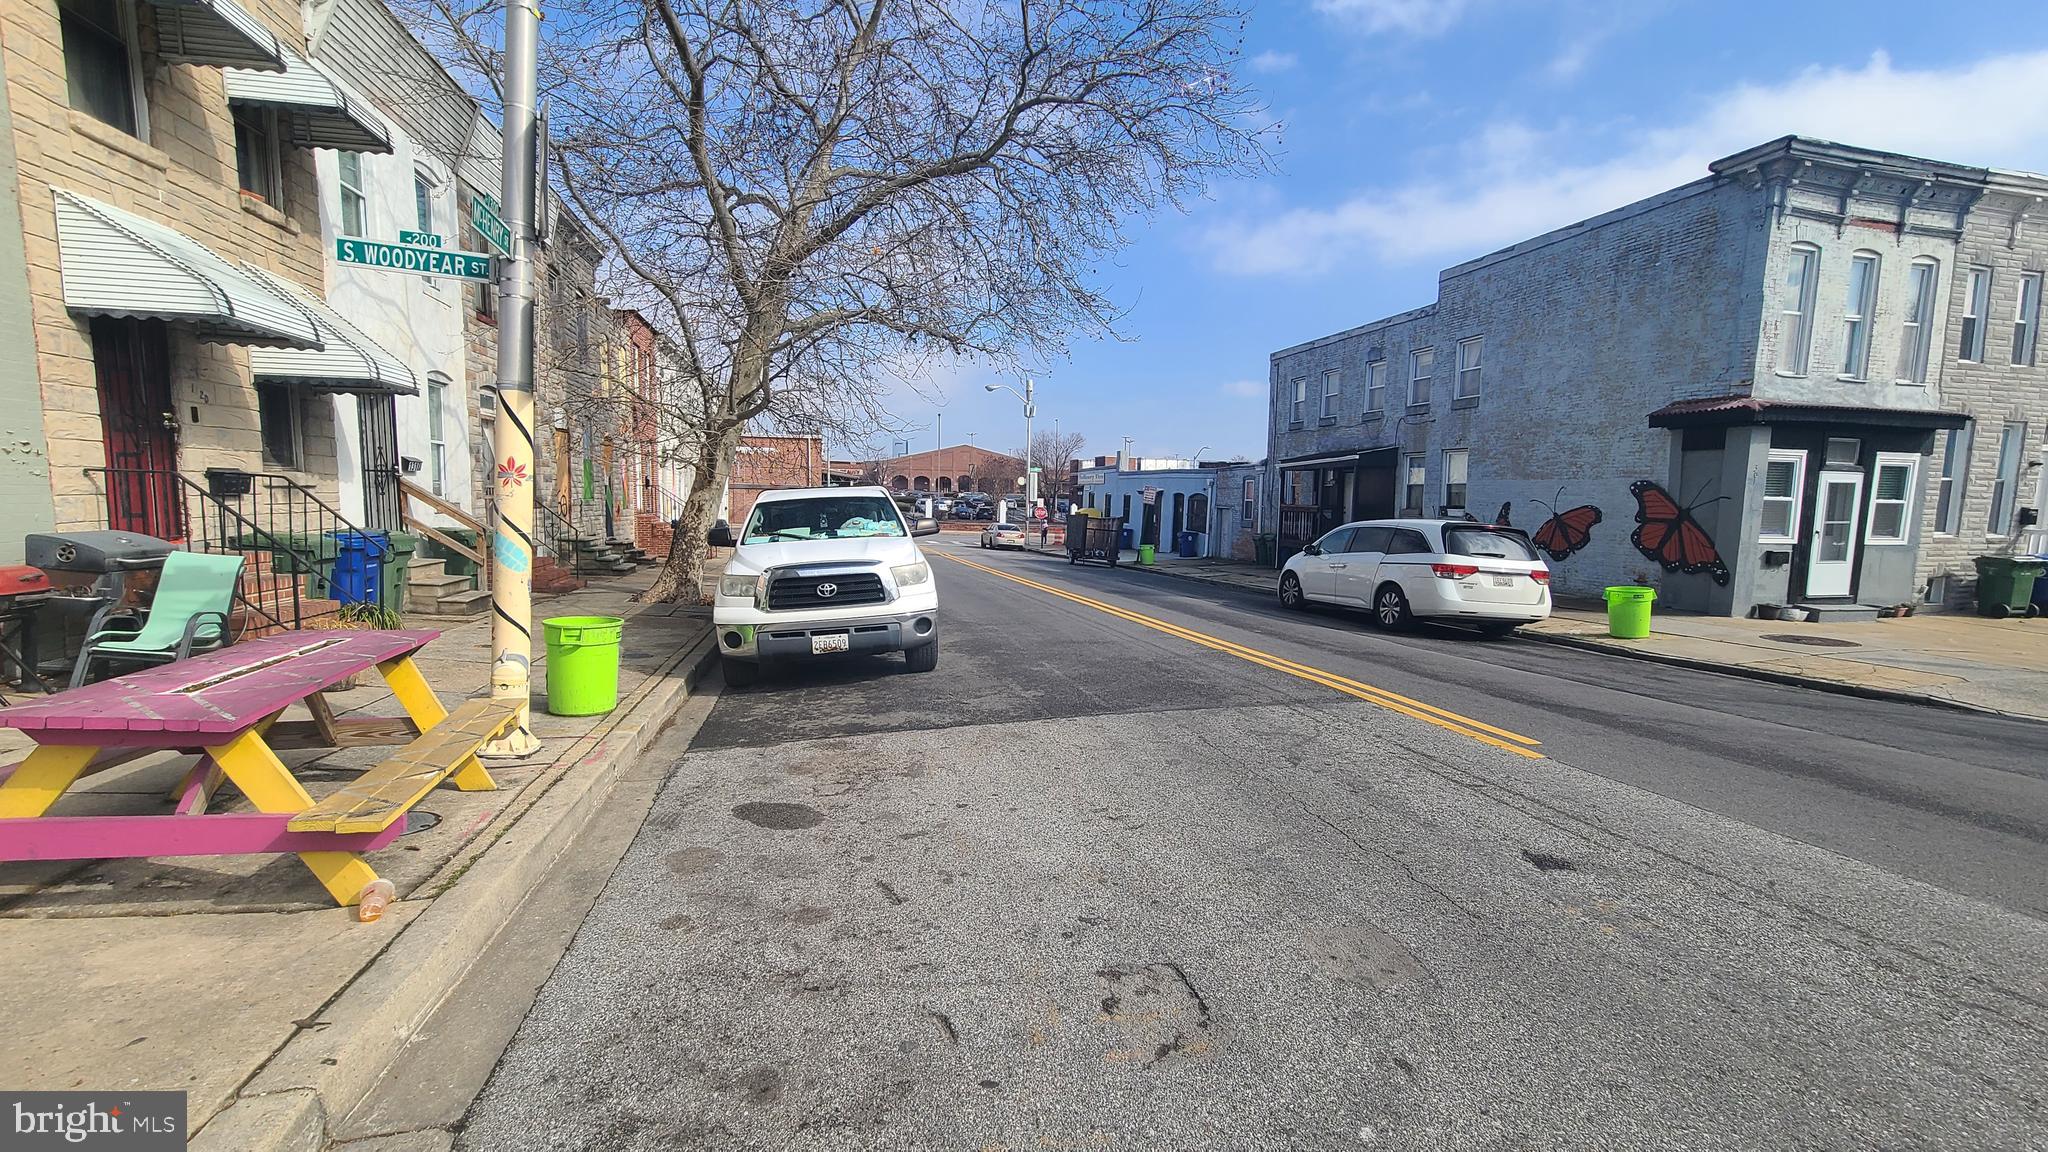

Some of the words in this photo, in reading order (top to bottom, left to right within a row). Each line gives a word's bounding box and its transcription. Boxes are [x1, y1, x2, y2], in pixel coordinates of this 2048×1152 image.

[412, 233, 437, 247] 200
[343, 242, 359, 262] S.
[364, 244, 465, 276] WOODYEAR
